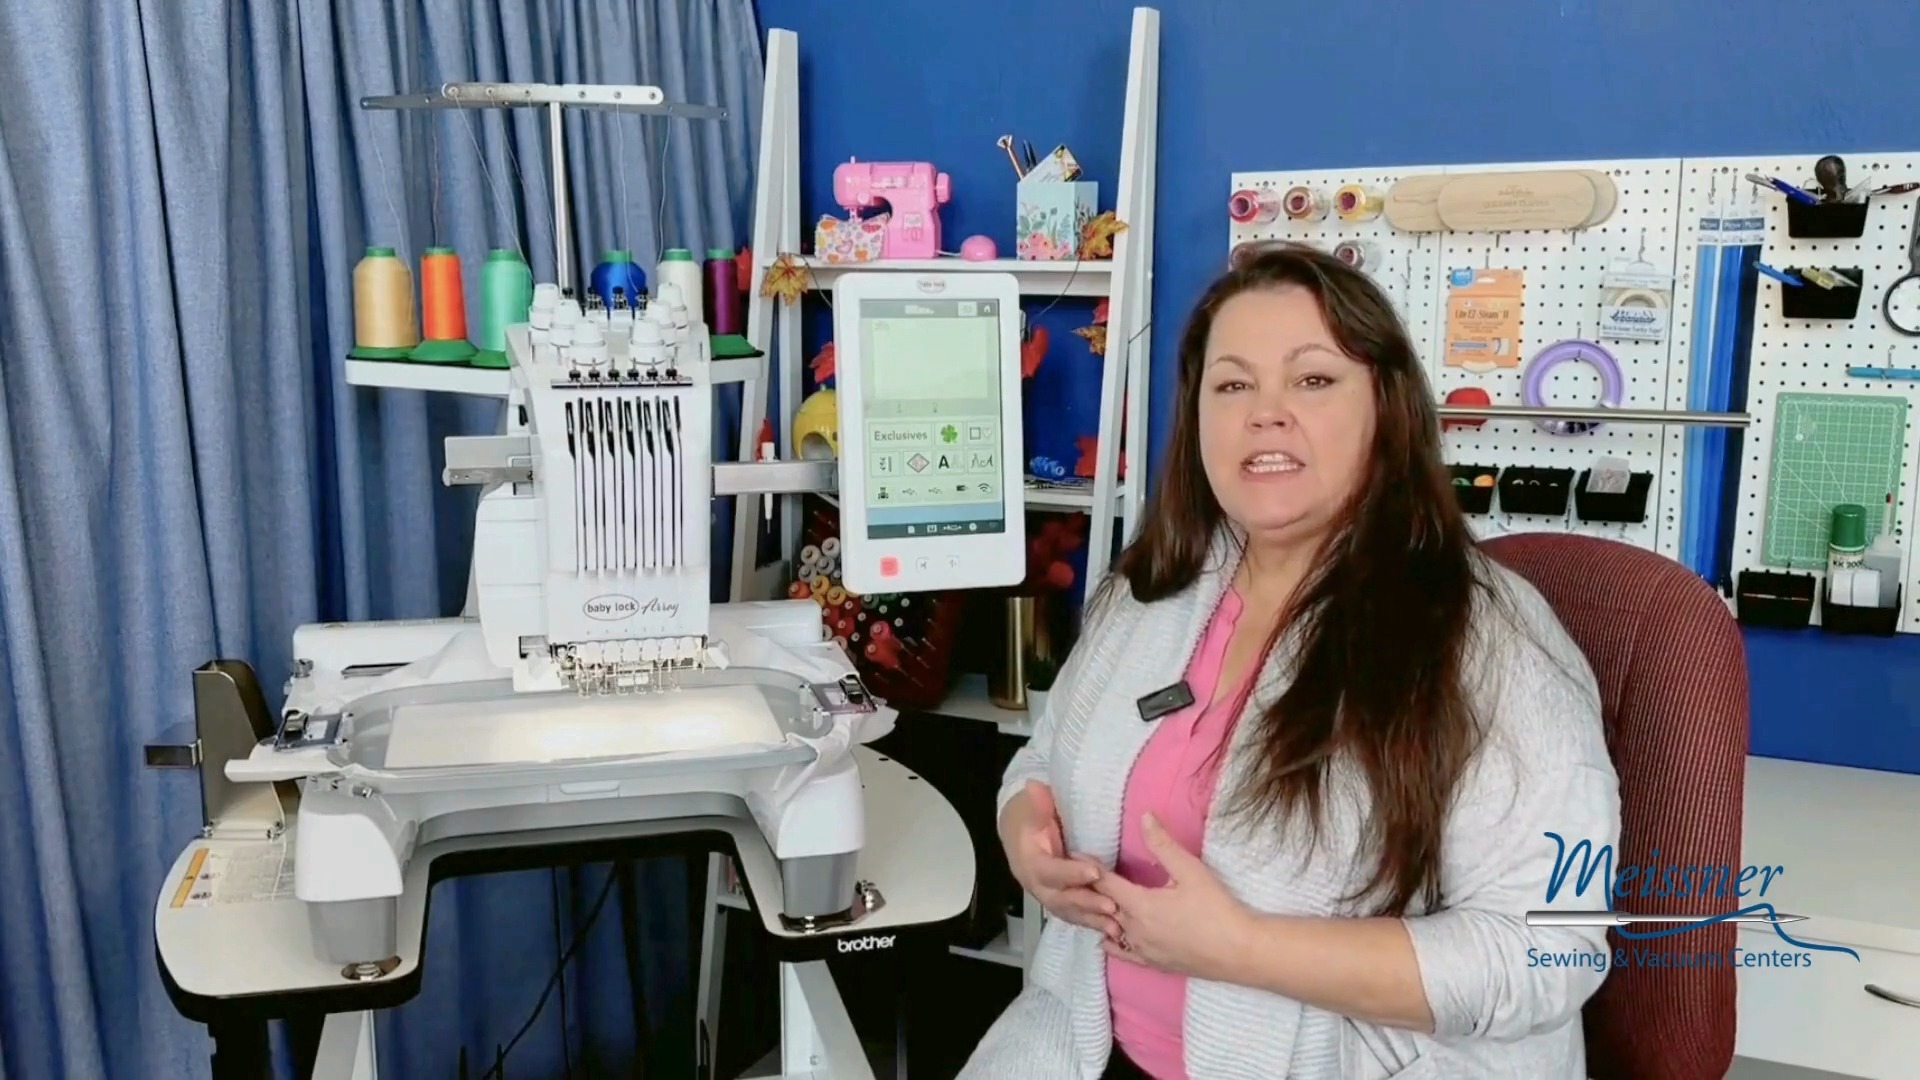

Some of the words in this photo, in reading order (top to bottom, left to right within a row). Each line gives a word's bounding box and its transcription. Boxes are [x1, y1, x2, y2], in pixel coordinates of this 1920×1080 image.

[874, 430, 928, 441] Exclusives
[587, 603, 611, 614] baby
[615, 602, 636, 612] lock
[641, 597, 679, 618] Array
[837, 934, 897, 953] brother
